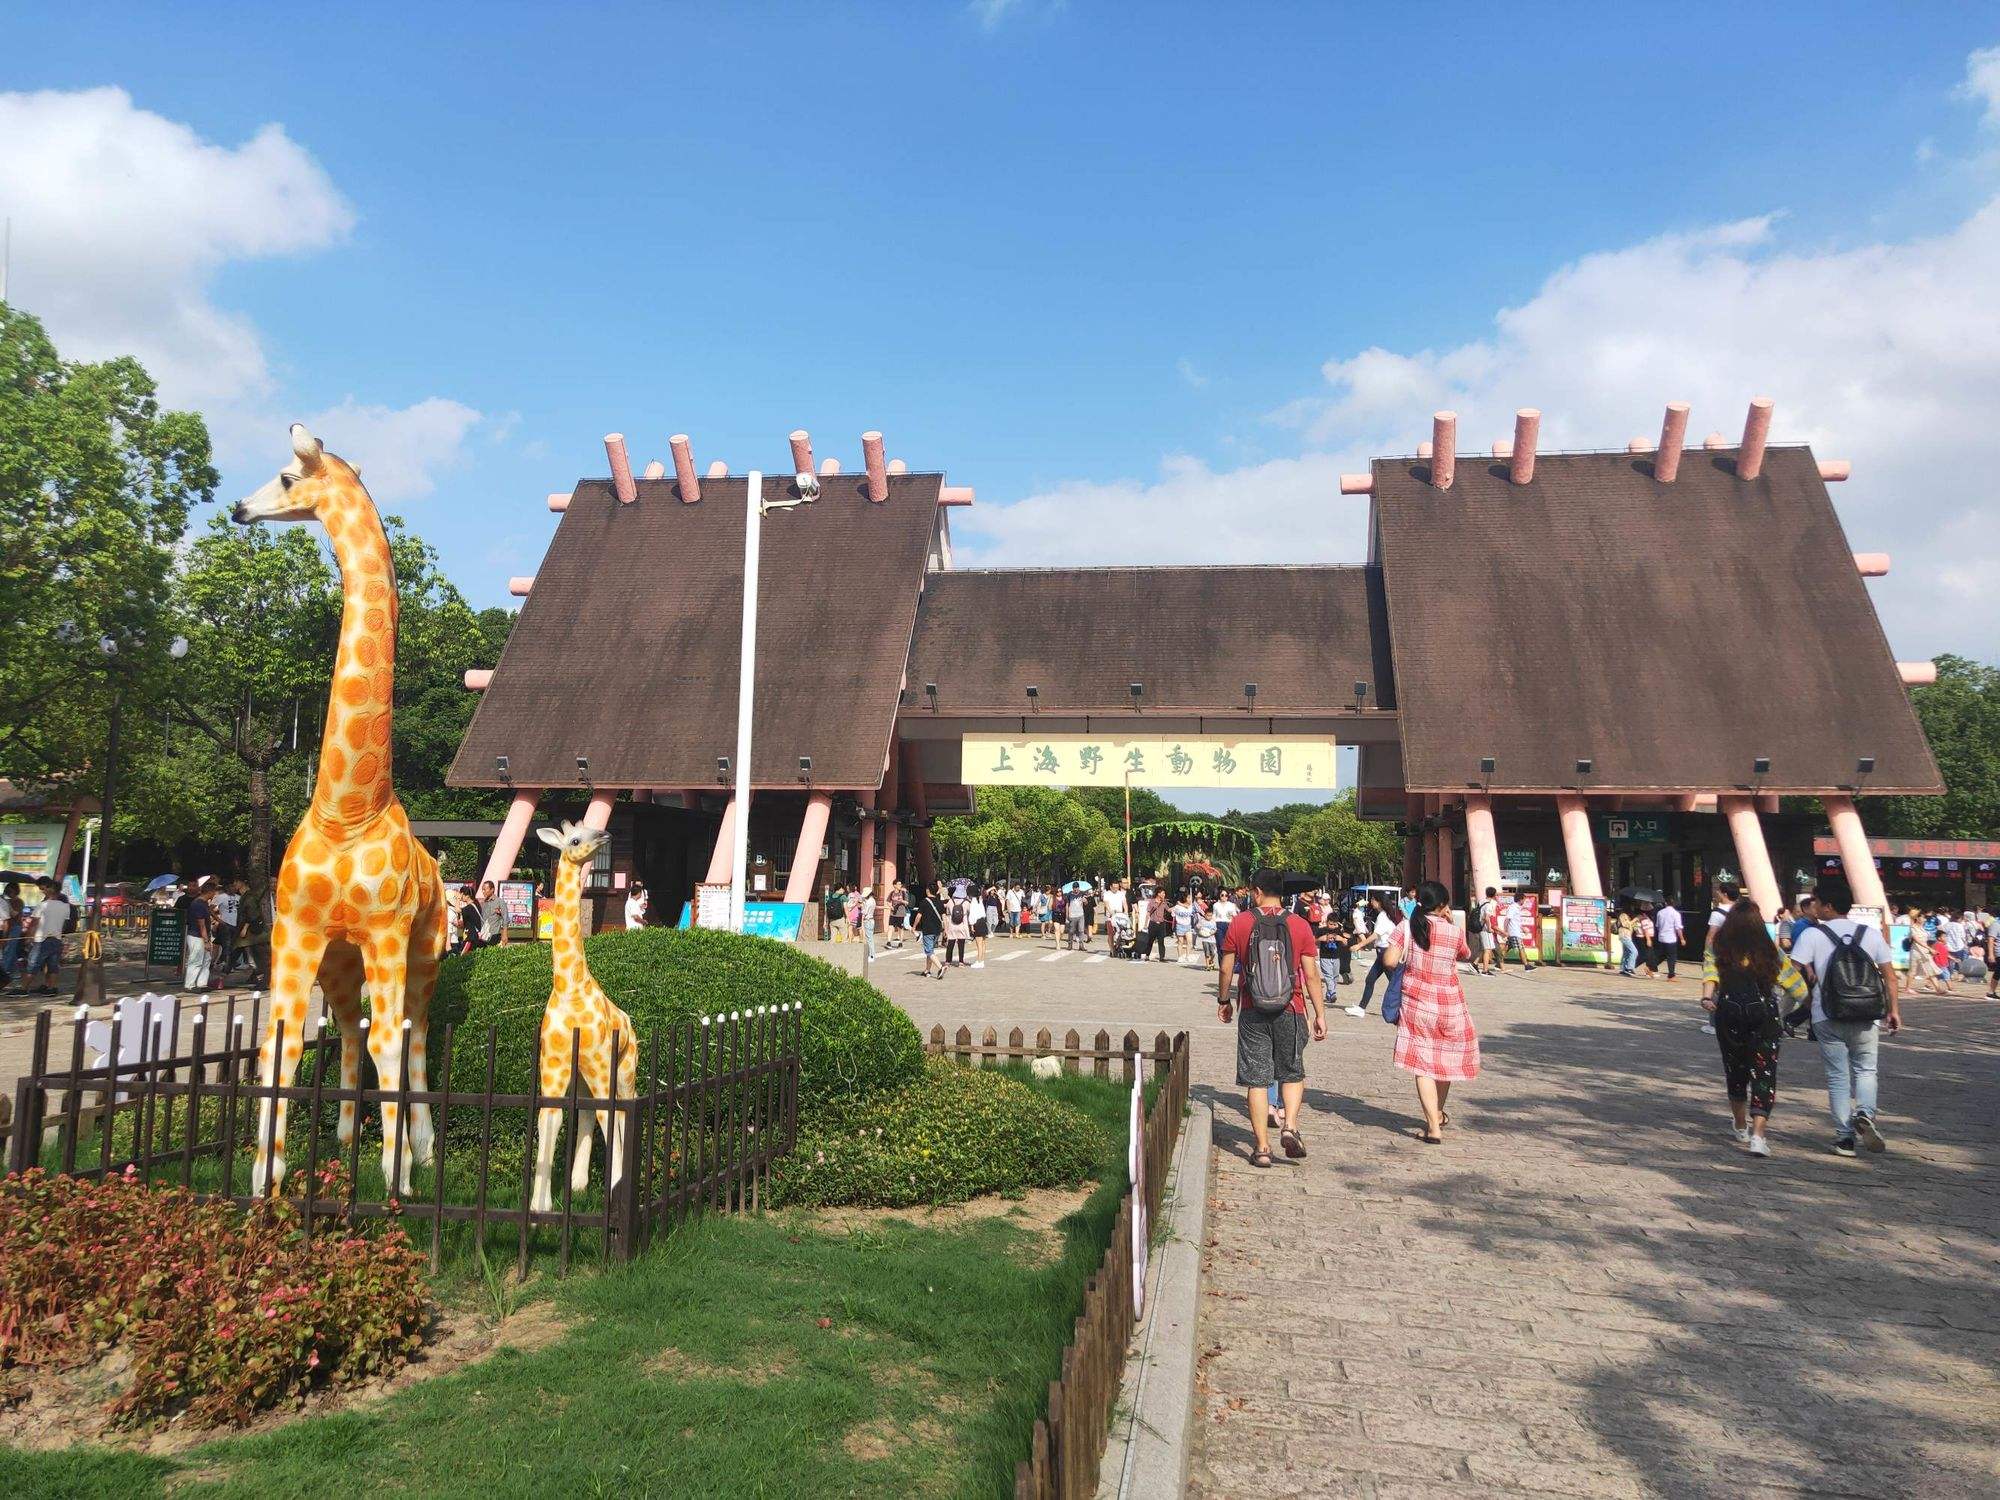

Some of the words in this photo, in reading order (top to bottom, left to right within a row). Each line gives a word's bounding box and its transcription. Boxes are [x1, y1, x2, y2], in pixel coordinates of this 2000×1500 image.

[991, 744, 1282, 776] 上海野生動物園
[1633, 820, 1657, 830] 入口
